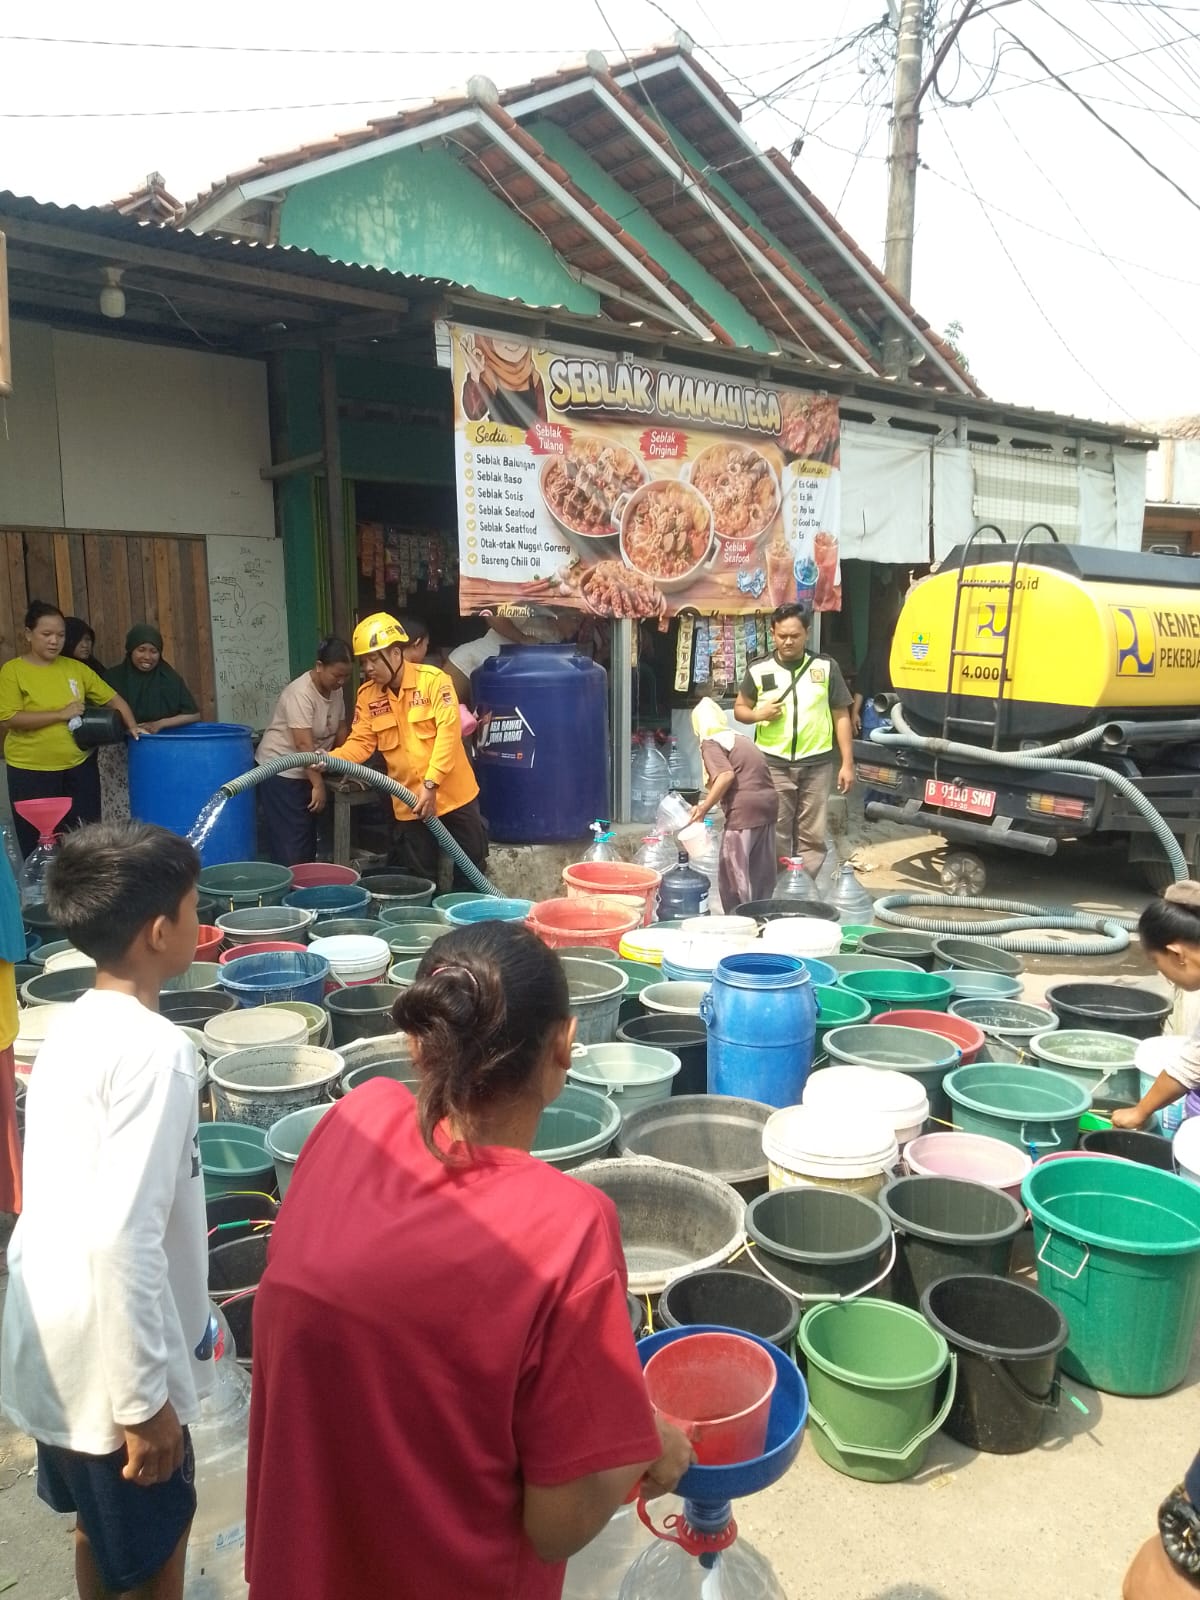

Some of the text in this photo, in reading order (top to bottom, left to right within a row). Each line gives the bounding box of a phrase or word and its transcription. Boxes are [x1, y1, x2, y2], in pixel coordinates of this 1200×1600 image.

[550, 359, 653, 411] SEBLAK
[658, 372, 744, 425] MAMAH
[535, 424, 562, 439] Seblak
[651, 430, 676, 444] Seblak
[539, 438, 564, 454] Tulang
[650, 443, 679, 459] Original
[476, 453, 536, 471] Seblak Balungan
[477, 470, 523, 485] Seblak Baso
[477, 487, 524, 501] Seblak Sosis
[478, 504, 535, 519] Seblak Seafood
[480, 521, 503, 533] Seblak
[798, 518, 810, 527] Good
[480, 537, 516, 550] Otak-otak
[544, 542, 571, 555] Goreng
[724, 540, 747, 552] Seblak
[481, 554, 541, 568] Basreng Chili Oil
[724, 552, 750, 563] Seafood
[961, 665, 999, 681] 4.000
[503, 730, 524, 743] BARAT
[928, 782, 992, 808] B 9110 SMA
